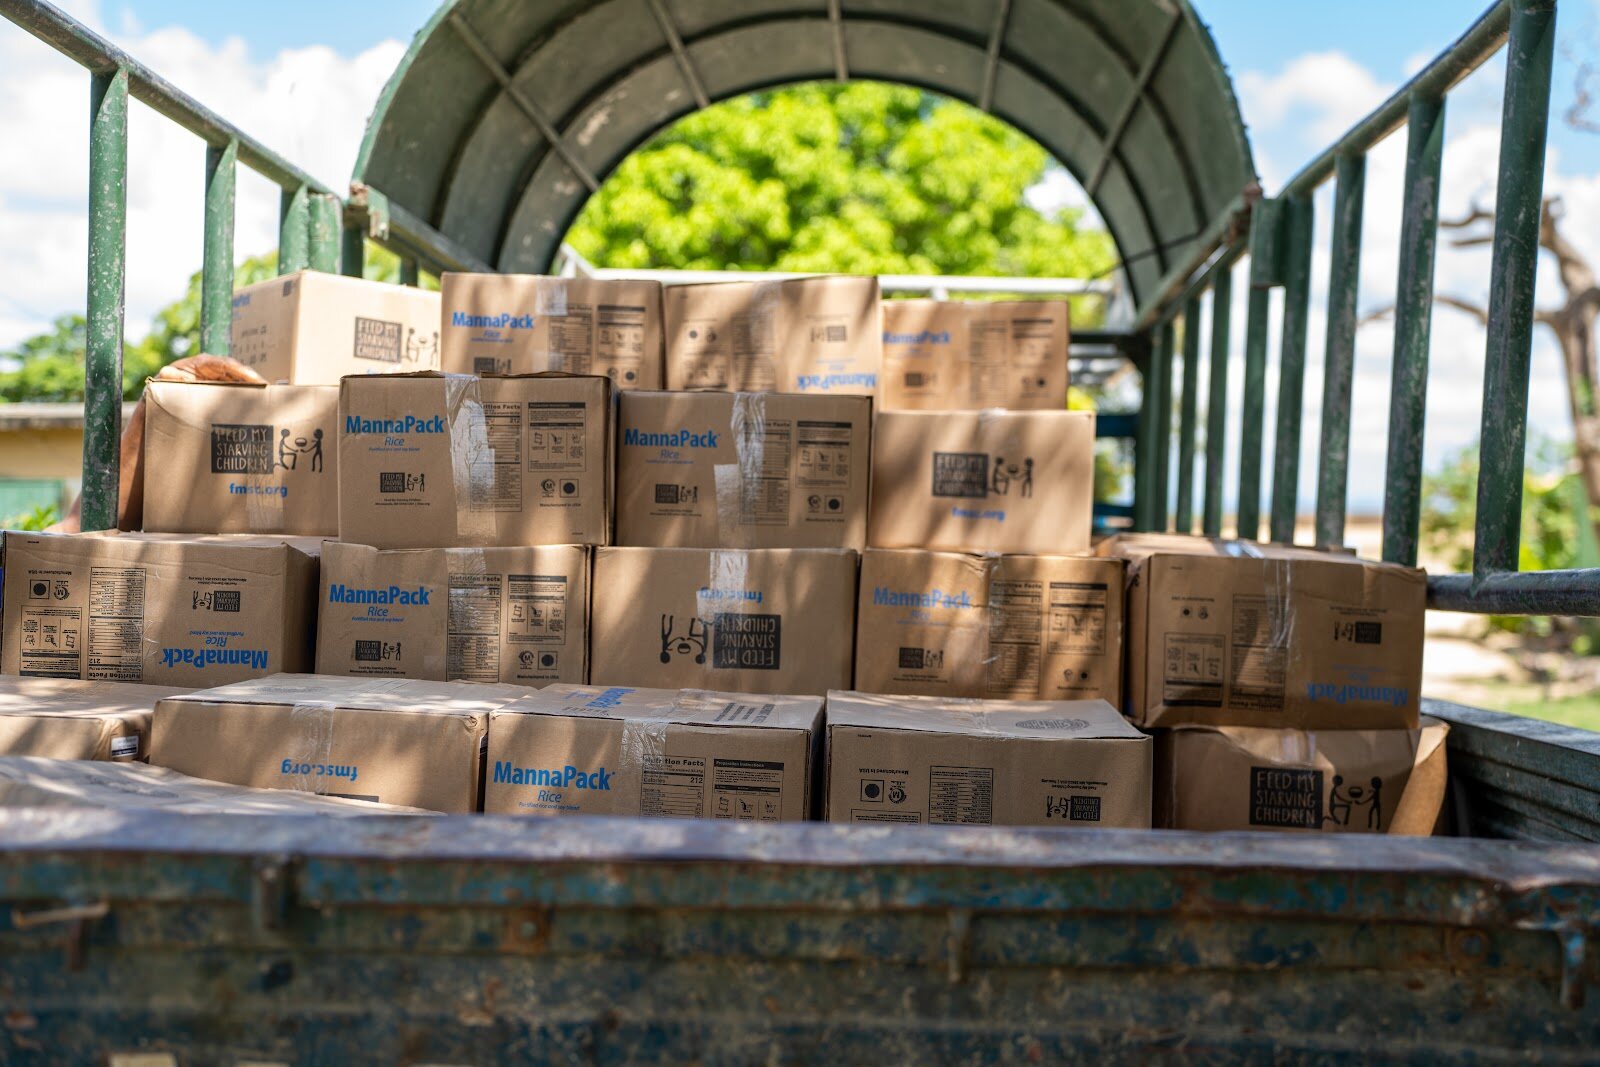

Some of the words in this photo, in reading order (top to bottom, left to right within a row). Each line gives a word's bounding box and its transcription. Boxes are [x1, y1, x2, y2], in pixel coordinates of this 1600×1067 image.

[358, 319, 384, 337] FEED
[452, 312, 534, 329] MannaPack
[797, 373, 876, 391] MannaPack
[346, 416, 445, 434] MannaPack
[215, 428, 247, 442] FEED
[251, 428, 267, 442] MY
[385, 437, 405, 446] Rice
[624, 428, 718, 448] MannaPack
[216, 444, 268, 456] STARVING
[660, 449, 680, 458] Rice
[216, 458, 268, 470] CHILDREN
[230, 483, 288, 497] fmsc.org
[330, 584, 430, 606] MannaPack
[874, 586, 970, 609] MannaPack
[368, 606, 388, 617] Rice
[721, 617, 776, 633] CHILDREN
[205, 636, 227, 647] Rice
[721, 634, 776, 648] STARVING
[162, 648, 268, 670] MannaPack
[720, 649, 737, 664] MY
[742, 650, 774, 666] FEED
[1307, 682, 1408, 708] MannaPack
[281, 759, 358, 782] fmsc.org
[683, 759, 704, 767] Facts
[494, 761, 611, 790] MannaPack
[1256, 771, 1292, 790] FEED
[1297, 774, 1316, 792] MY
[538, 790, 562, 803] Rice
[1256, 790, 1316, 807] STARVING
[1256, 808, 1316, 825] CHILDREN
